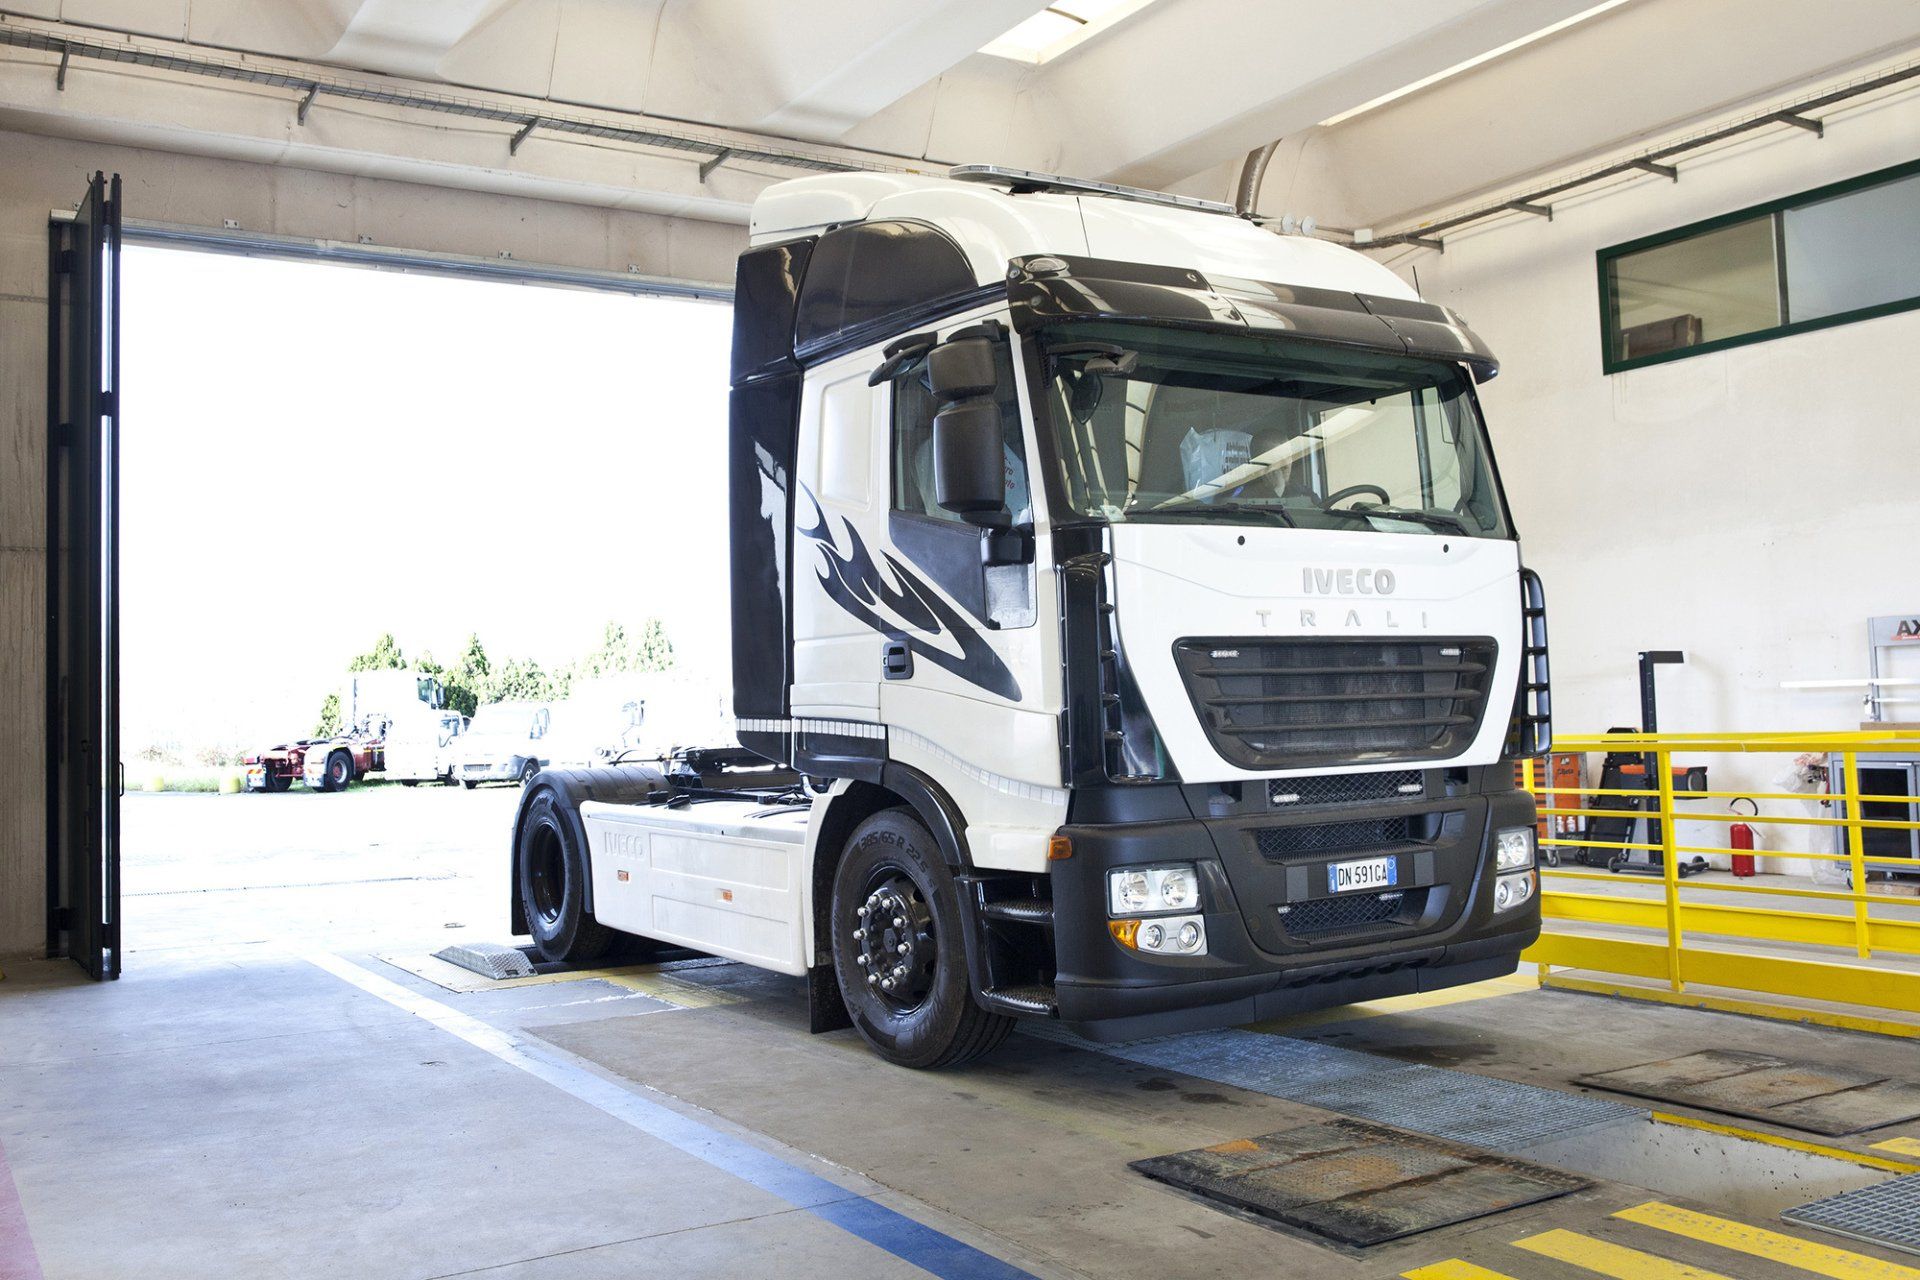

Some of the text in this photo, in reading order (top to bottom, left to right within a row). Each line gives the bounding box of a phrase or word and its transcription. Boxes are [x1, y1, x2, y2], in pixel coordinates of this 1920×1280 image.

[1302, 567, 1396, 595] IVECO
[604, 831, 645, 861] IVECO
[1338, 868, 1352, 886] DN
